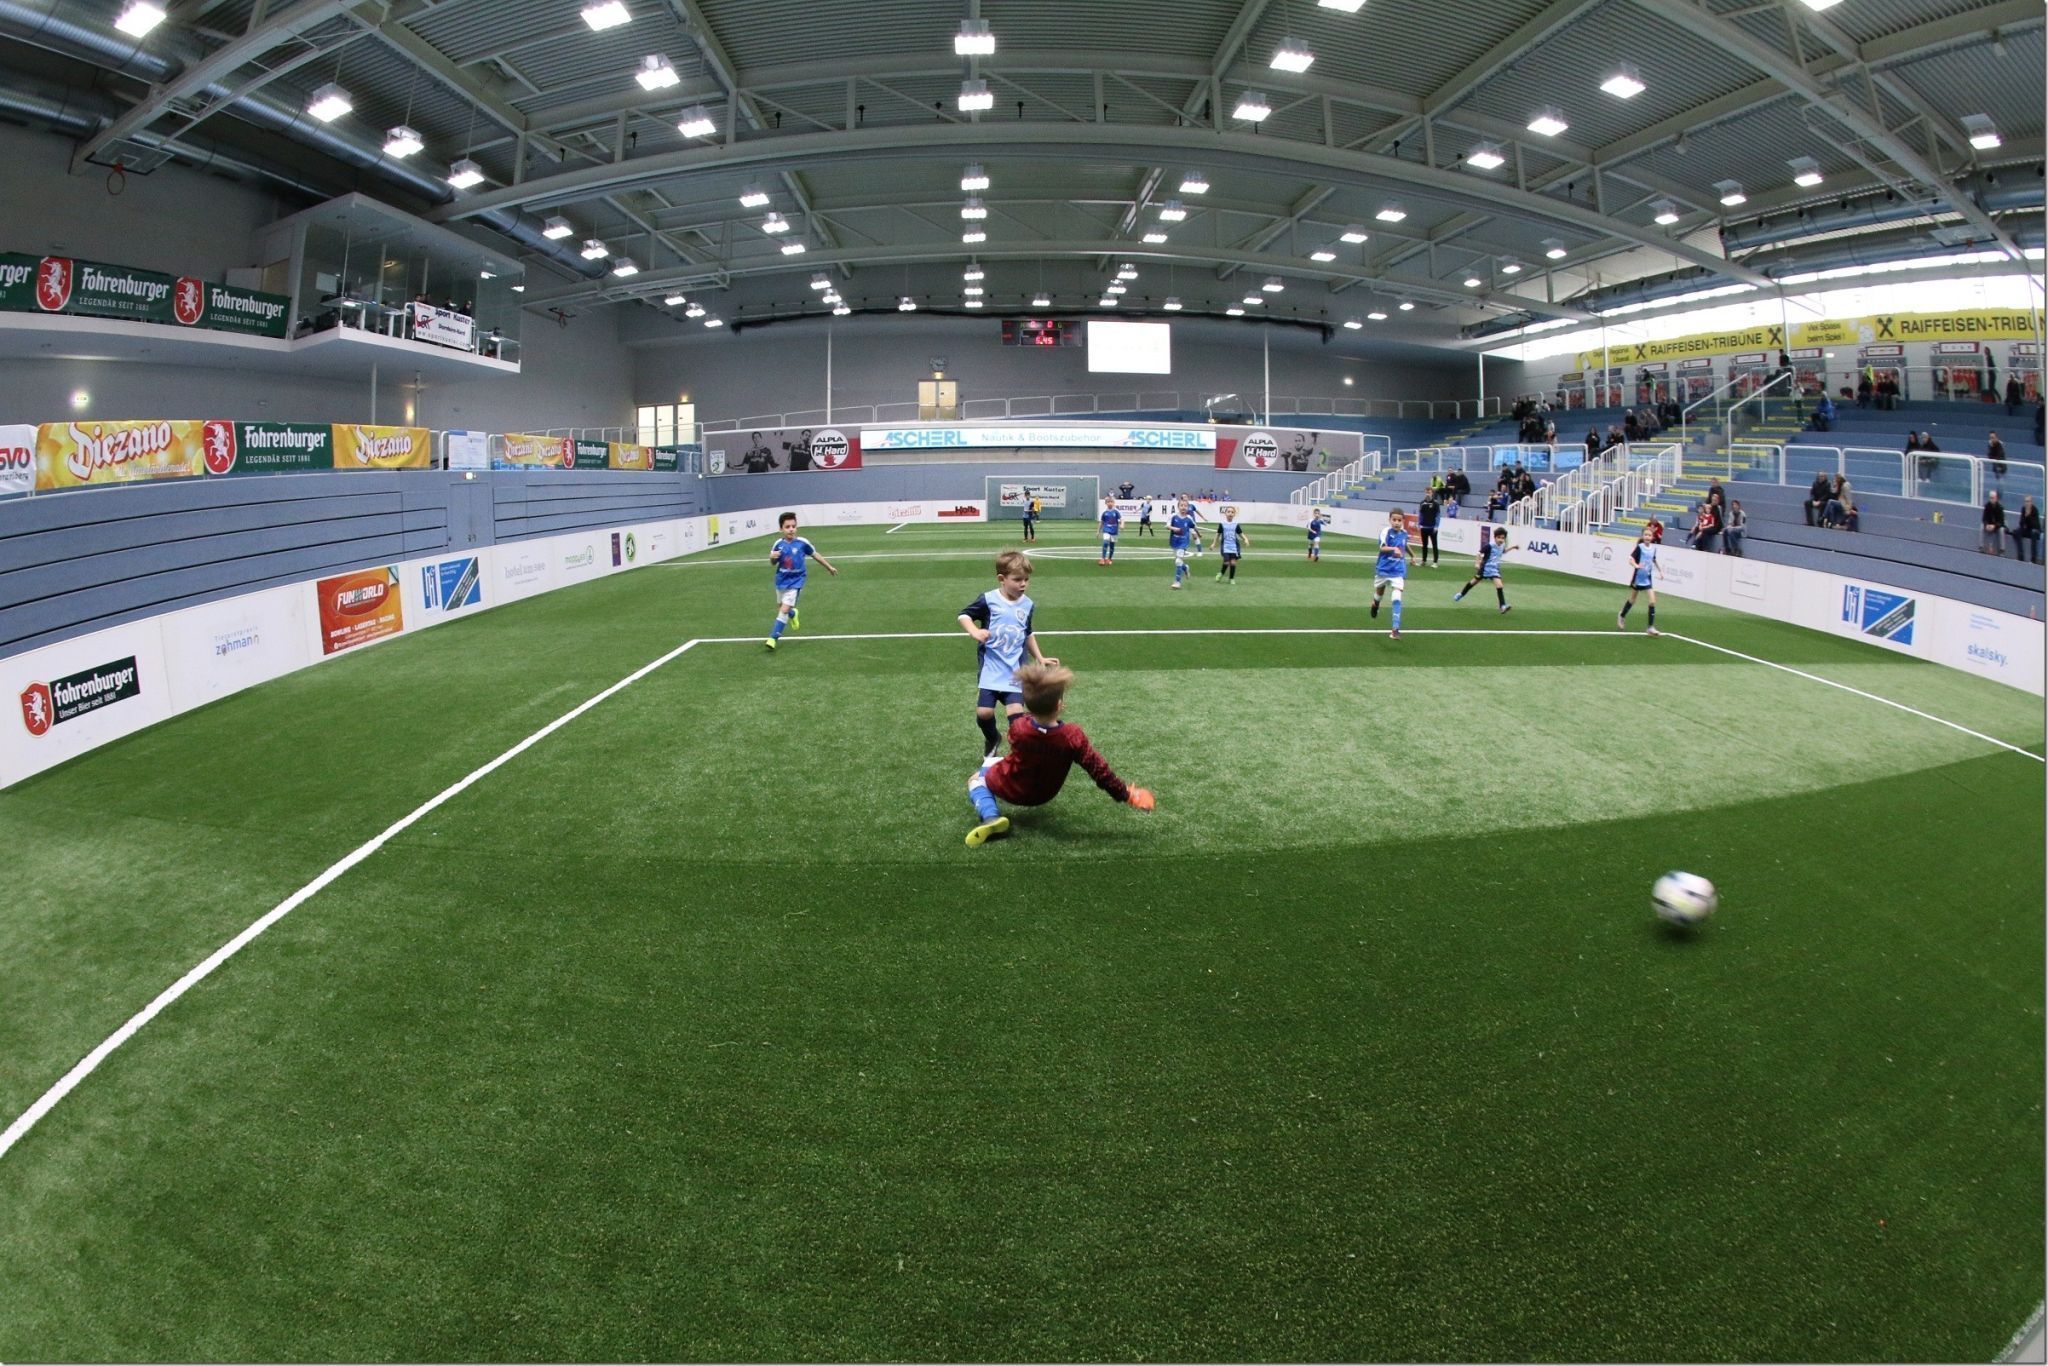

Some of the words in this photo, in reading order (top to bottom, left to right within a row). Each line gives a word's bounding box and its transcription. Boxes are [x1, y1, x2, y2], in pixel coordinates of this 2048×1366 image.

[81, 267, 170, 302] Fohrenburger
[212, 288, 284, 320] Fohrenburger
[1650, 332, 1763, 356] RAIFFEISEN-TRIBÜNE
[67, 421, 173, 481] Diezano
[244, 426, 327, 452] Fohrenburger
[356, 425, 413, 465] Diezano
[245, 455, 280, 464] LEGENDÄR
[281, 455, 296, 463] SEIT
[1527, 541, 1560, 556] ALPLA
[53, 667, 134, 708] fohrenburger
[58, 706, 78, 719] Unser
[78, 701, 91, 712] Bier
[91, 696, 104, 706] seit
